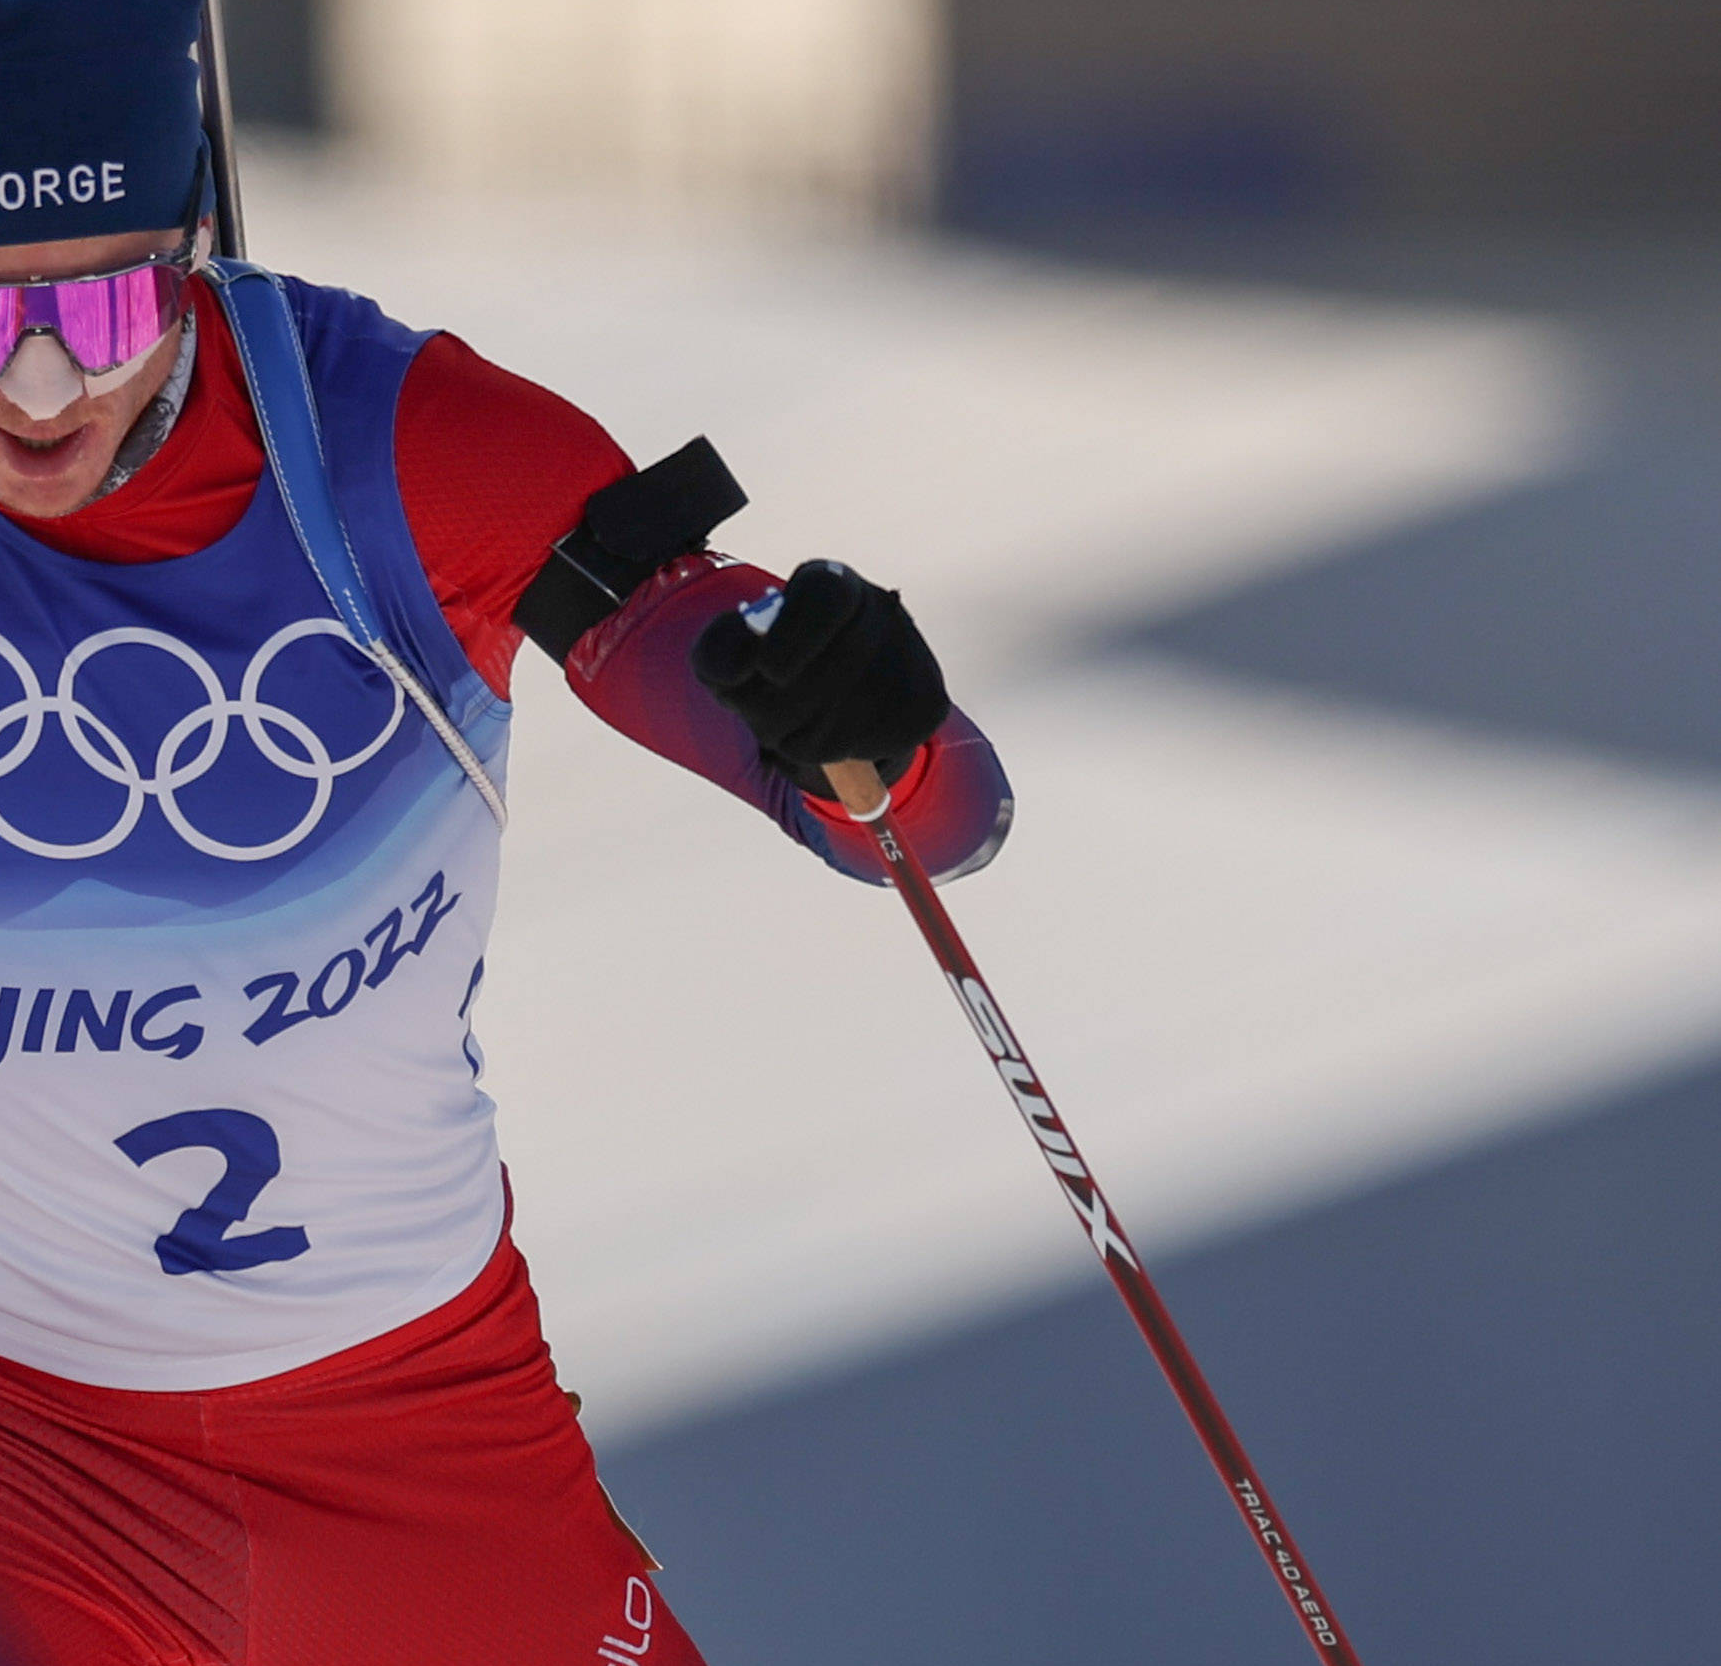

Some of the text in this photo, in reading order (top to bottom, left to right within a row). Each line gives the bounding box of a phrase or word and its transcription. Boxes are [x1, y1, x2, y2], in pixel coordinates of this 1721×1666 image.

[876, 829, 904, 862] TCS
[242, 869, 462, 1047] 2022
[113, 1108, 312, 1275] 2
[1235, 1477, 1283, 1554] TRIAC
[1291, 1581, 1338, 1647] AERO
